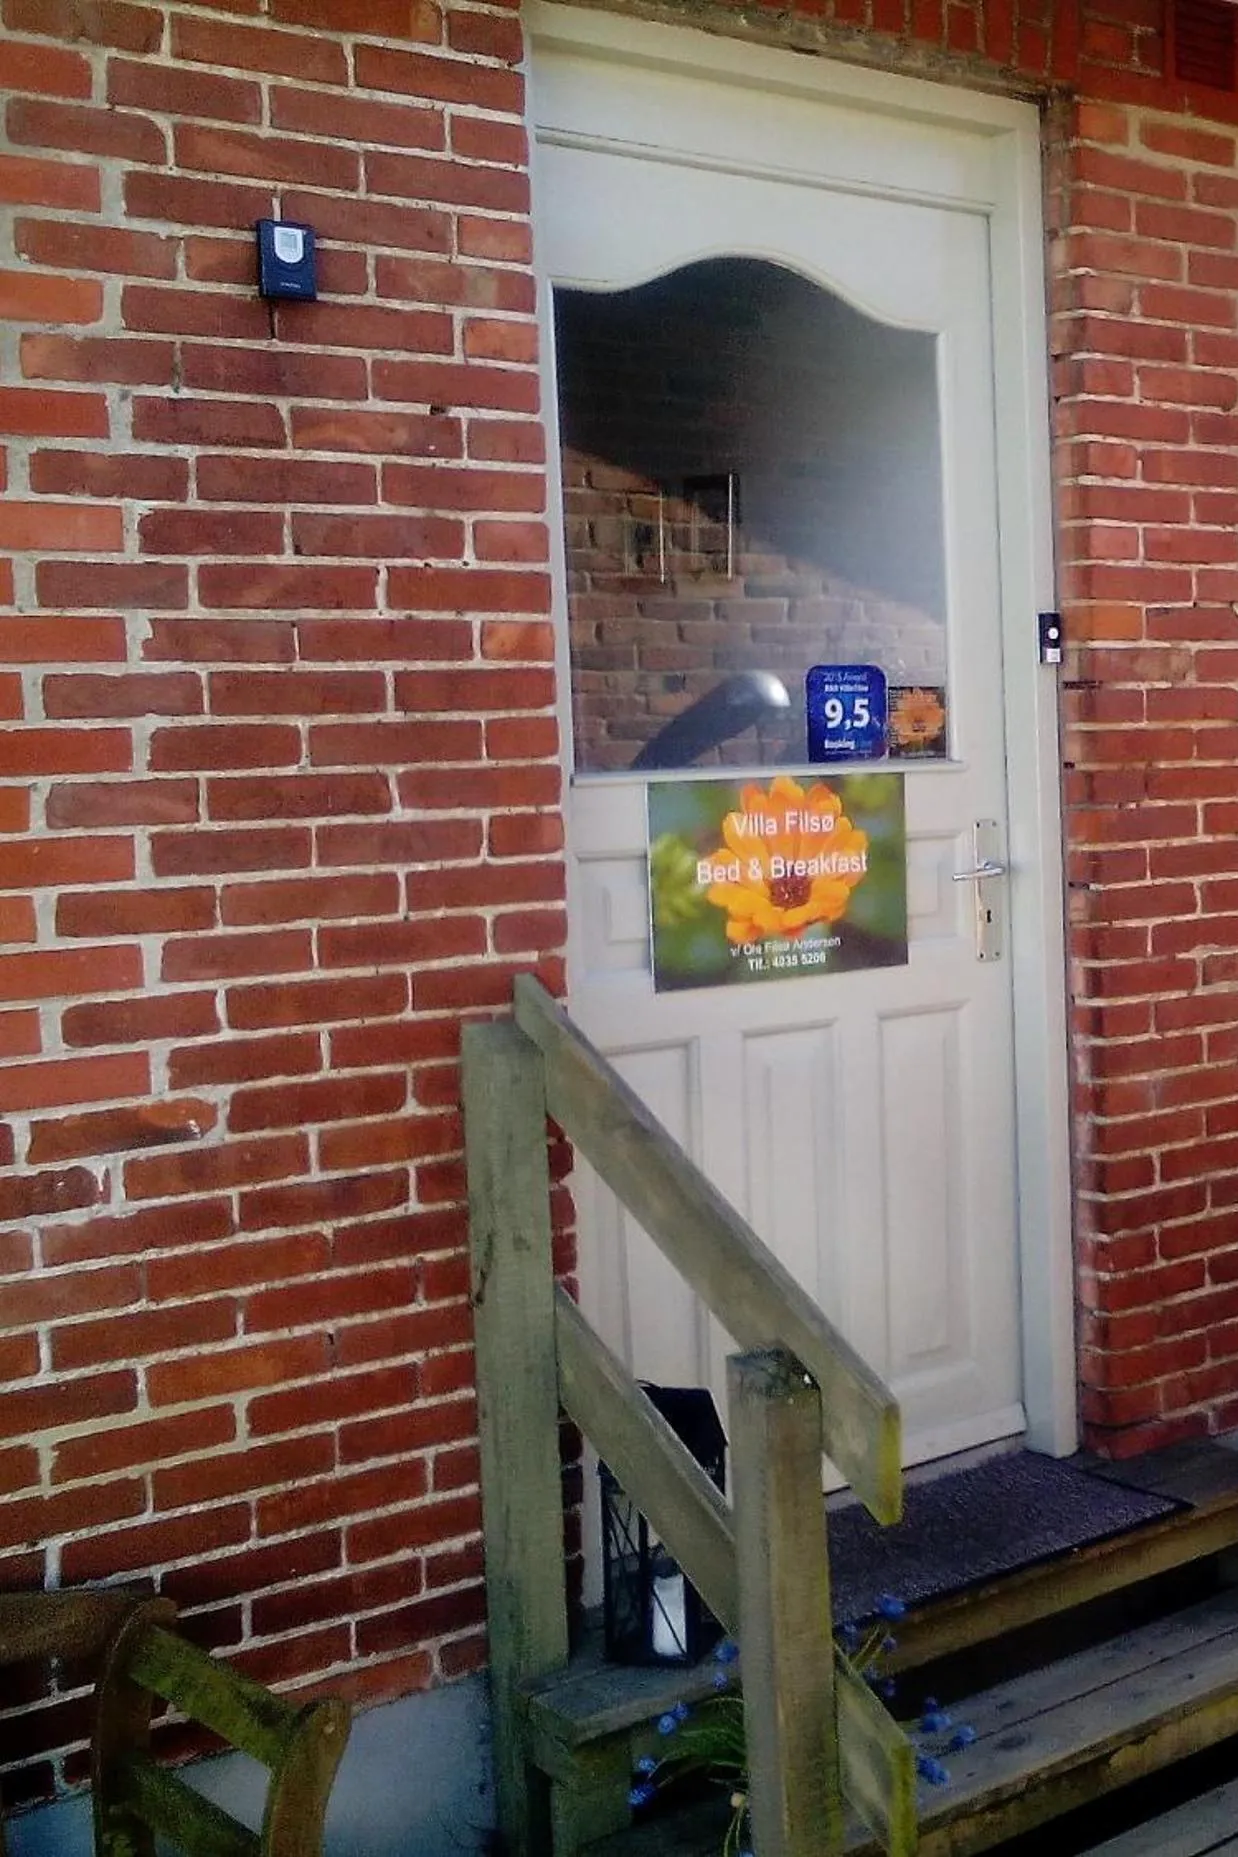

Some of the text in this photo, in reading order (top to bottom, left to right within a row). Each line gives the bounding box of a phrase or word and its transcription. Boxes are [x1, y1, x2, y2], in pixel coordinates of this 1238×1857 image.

[824, 698, 870, 730] 9,5
[732, 811, 835, 838] Villa Filsø
[697, 850, 868, 884] Bed & Breakfast
